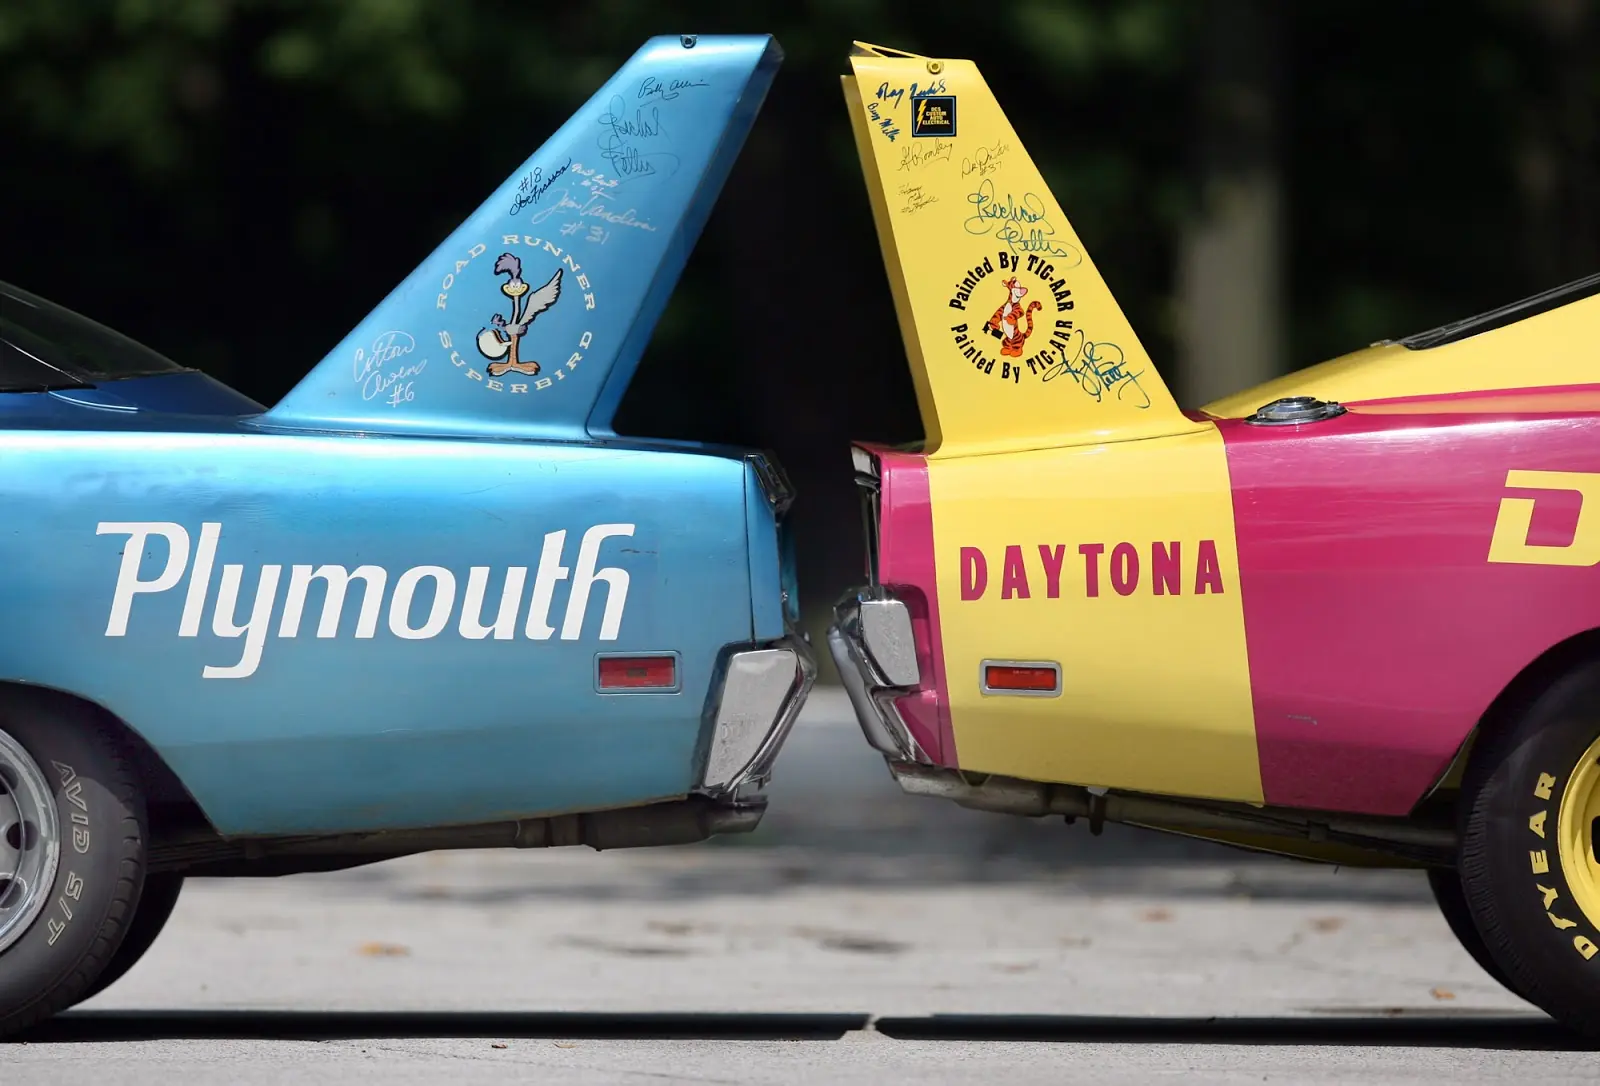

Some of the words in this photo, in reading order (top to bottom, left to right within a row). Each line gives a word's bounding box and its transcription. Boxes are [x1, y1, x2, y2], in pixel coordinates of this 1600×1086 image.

[518, 166, 542, 193] #18
[436, 243, 487, 310] ROAD
[502, 234, 596, 311] RUNNER
[949, 257, 994, 311] Painted
[998, 251, 1019, 272] By
[1027, 254, 1075, 312] TIG-AAR
[438, 330, 593, 394] SUPERBIRD
[951, 323, 996, 375] Painted
[1001, 362, 1020, 384] By
[96, 522, 635, 678] Plymouth
[960, 540, 1224, 601] DAYTONA
[51, 760, 90, 854] AVID
